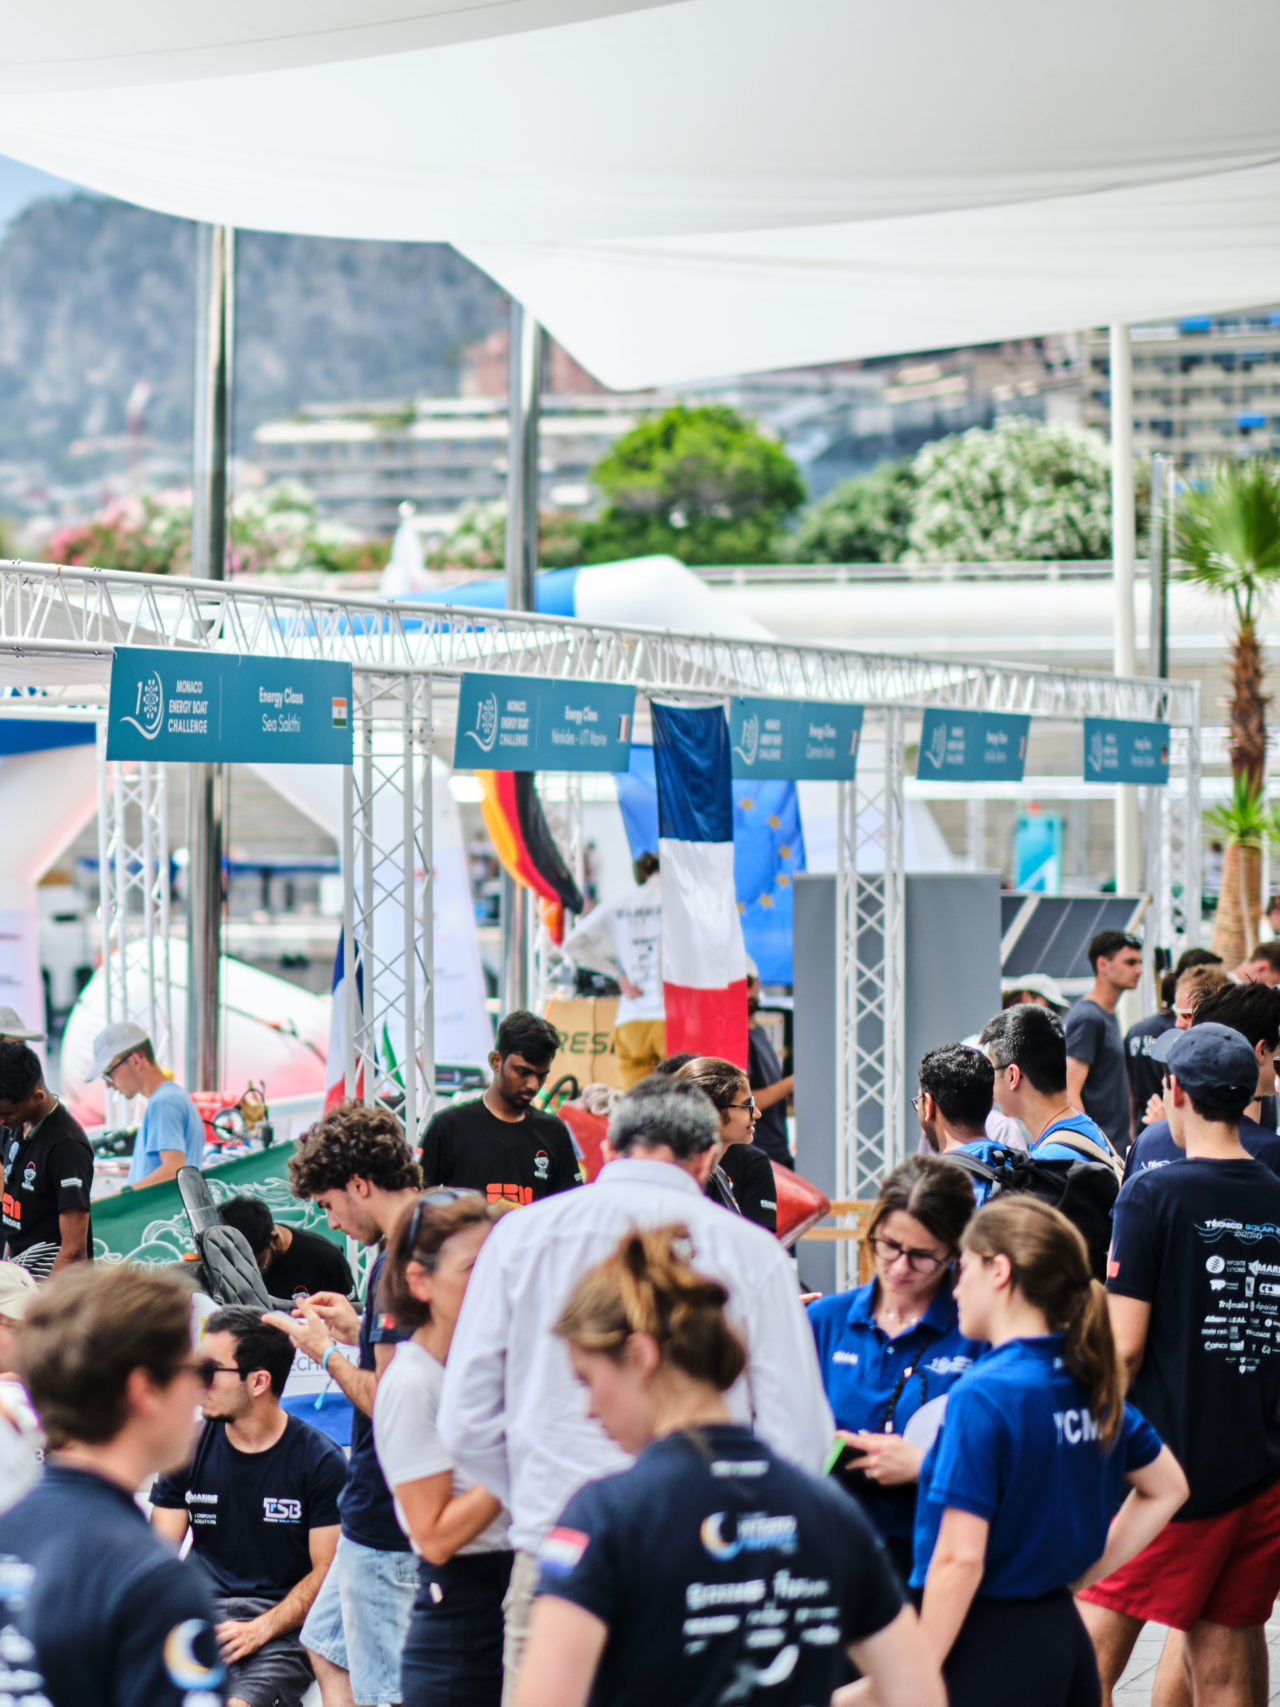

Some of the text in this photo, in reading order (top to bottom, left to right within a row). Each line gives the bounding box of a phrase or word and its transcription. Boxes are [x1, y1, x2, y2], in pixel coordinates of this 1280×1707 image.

[176, 680, 203, 694] MONACO
[258, 686, 304, 709] Energy Class
[168, 699, 209, 715] ENERGY BOAT
[167, 718, 208, 734] CHALLENGE
[261, 713, 279, 732] Sea
